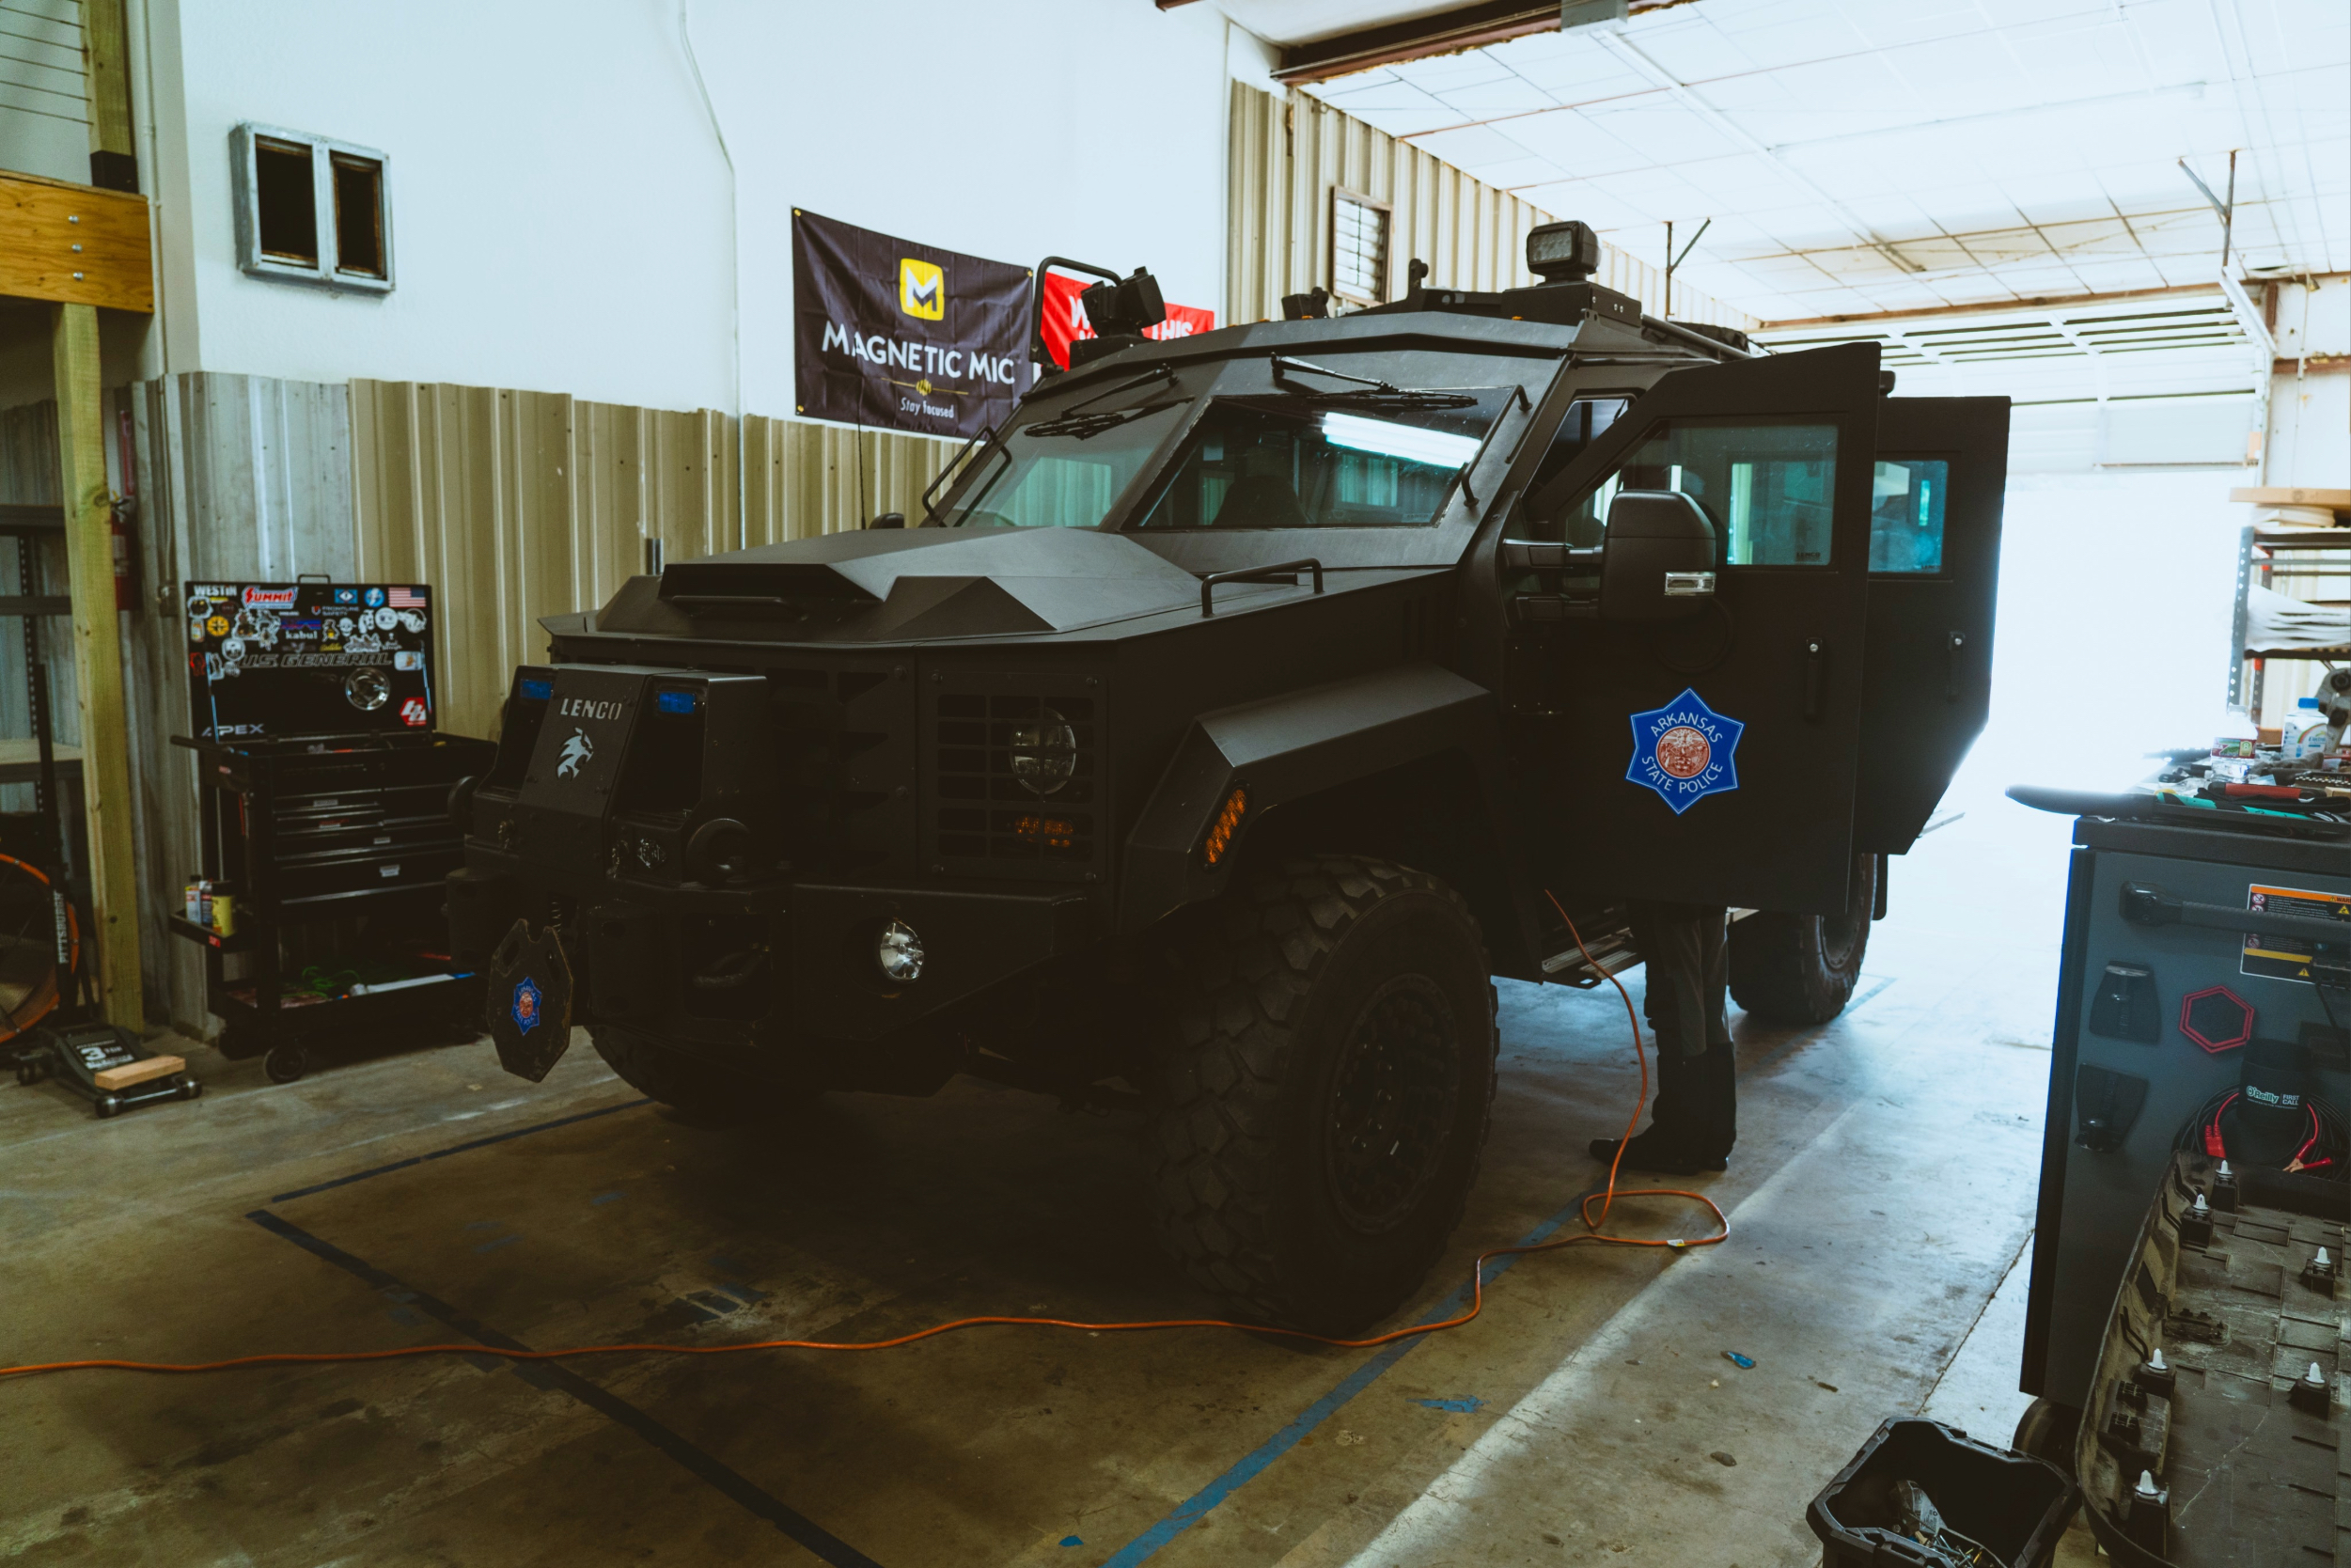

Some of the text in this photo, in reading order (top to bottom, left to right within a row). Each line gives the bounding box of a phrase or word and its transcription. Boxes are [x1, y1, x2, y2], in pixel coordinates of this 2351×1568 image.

[822, 320, 1015, 385] MAGNETIC MIC
[900, 397, 955, 419] Stay focused
[285, 630, 318, 639] kabul
[280, 651, 393, 668] GENERAL
[559, 698, 622, 720] LENCO
[1650, 712, 1723, 743] ARKANSAS
[1641, 756, 1723, 793] STATE POLICE
[80, 1046, 107, 1061] 3
[2246, 1085, 2280, 1105] O'Reilly
